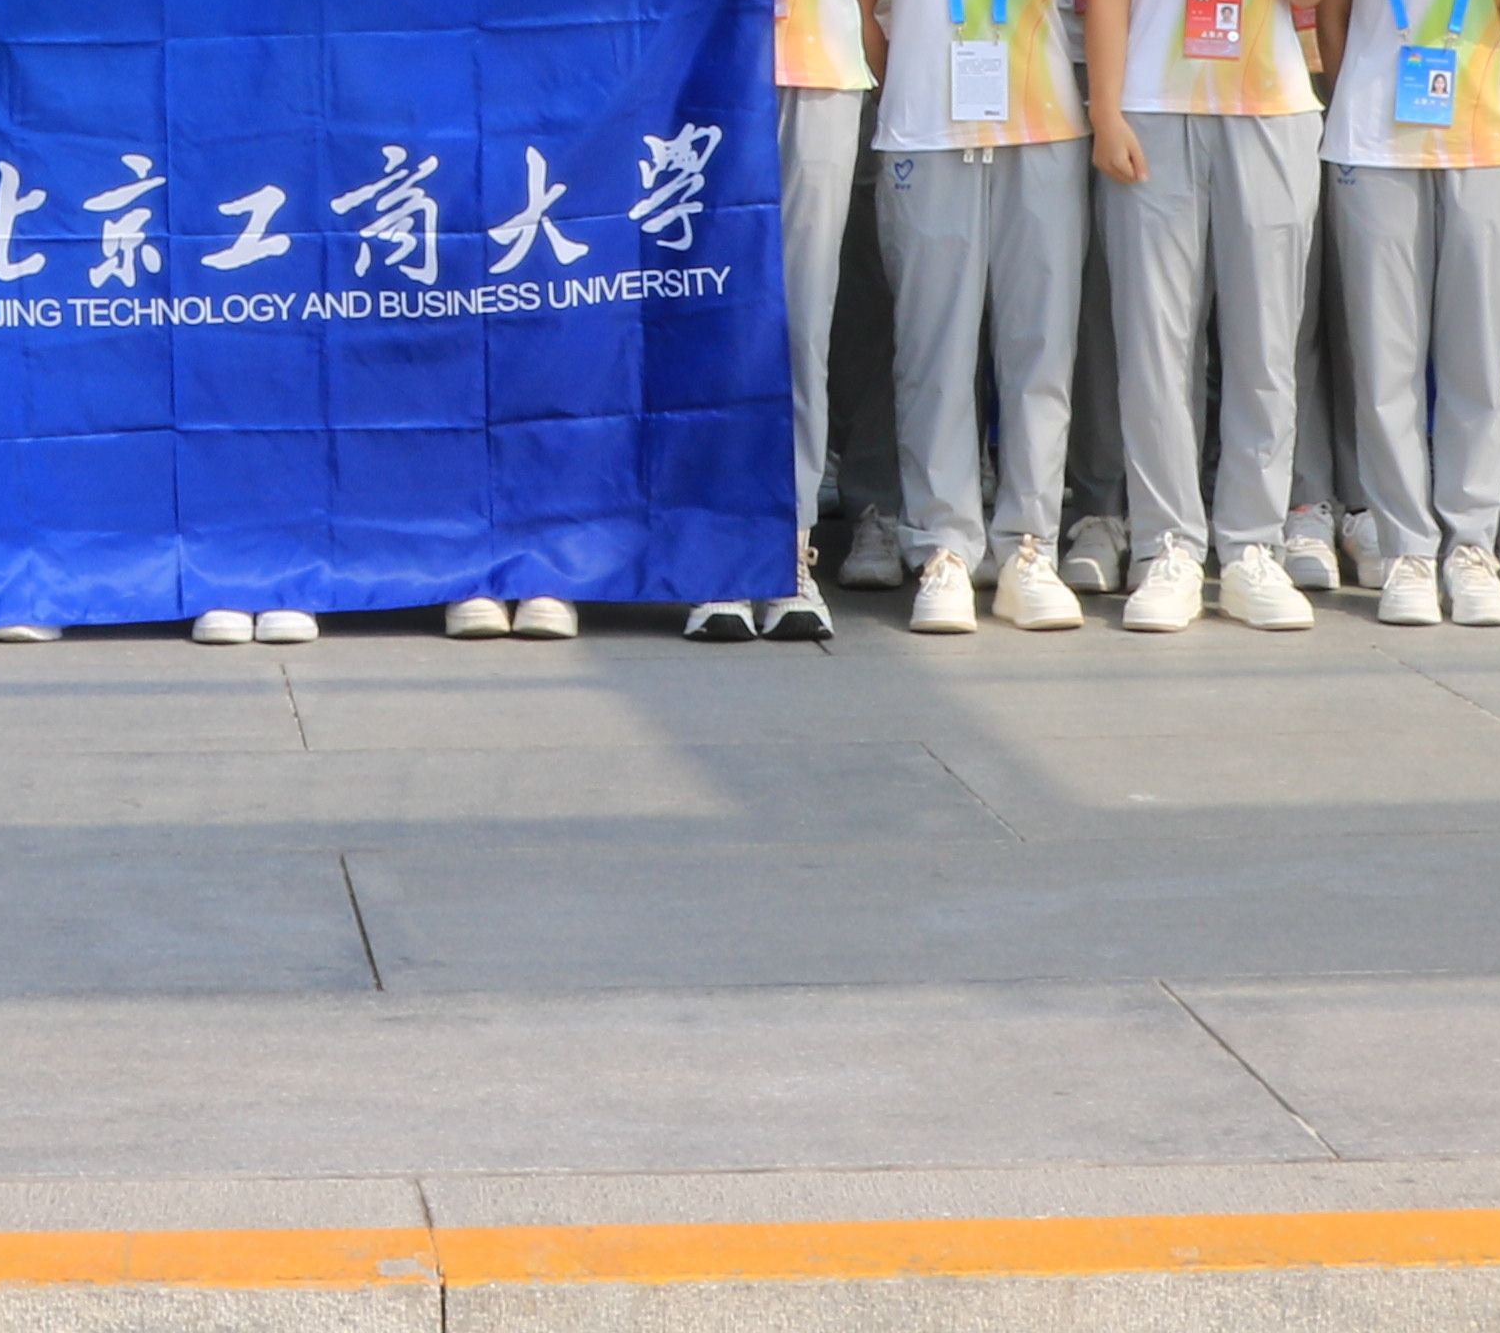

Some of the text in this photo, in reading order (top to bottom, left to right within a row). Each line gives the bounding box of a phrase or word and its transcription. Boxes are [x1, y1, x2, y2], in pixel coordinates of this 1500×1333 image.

[66, 292, 297, 327] TECHNOLOGY
[301, 290, 373, 320] AND
[379, 282, 542, 319] BUSINESS
[547, 265, 733, 309] UNIVERSITY
